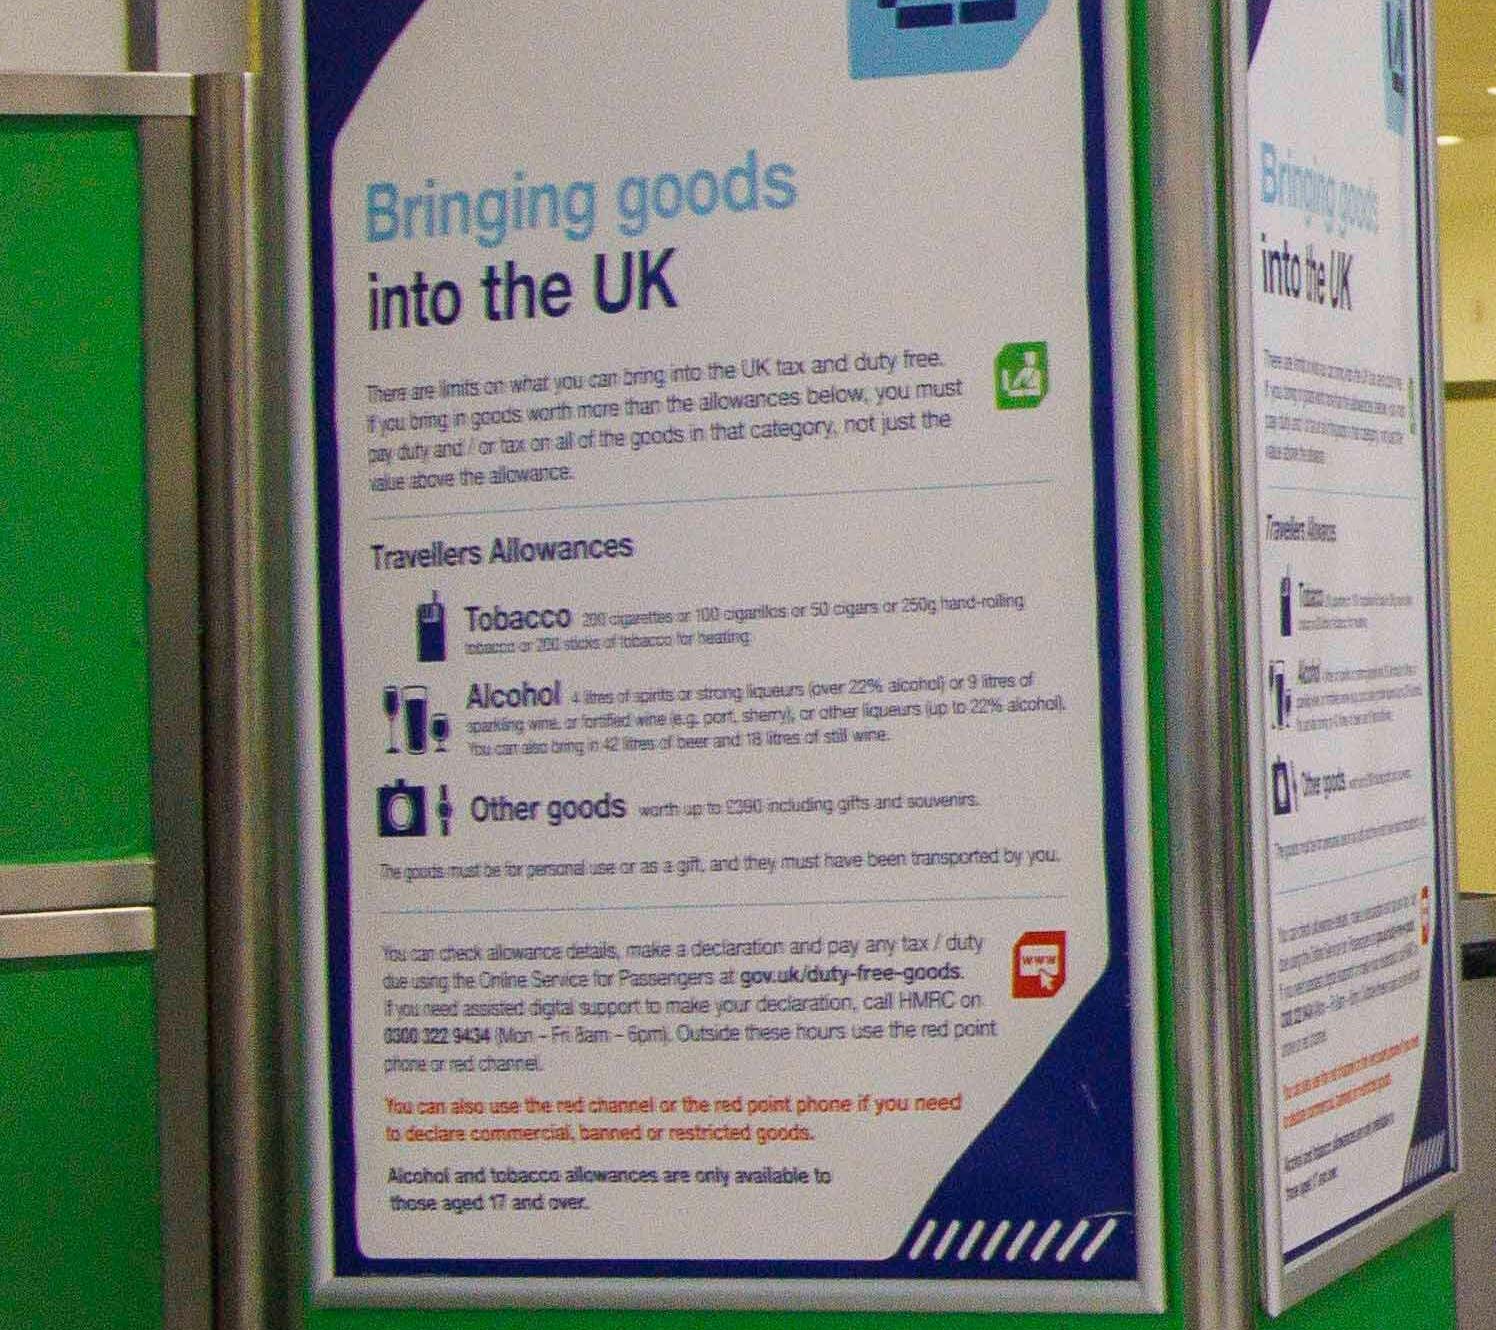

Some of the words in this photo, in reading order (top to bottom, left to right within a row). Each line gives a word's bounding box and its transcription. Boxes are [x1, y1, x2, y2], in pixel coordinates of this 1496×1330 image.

[366, 169, 596, 249] Bringing
[616, 148, 798, 237] goods
[1261, 232, 1301, 298] into
[1305, 243, 1326, 305] the
[1329, 249, 1354, 311] UK
[367, 271, 461, 331] into
[480, 260, 573, 322] the
[593, 247, 678, 314] UK
[366, 384, 408, 402] There
[410, 385, 436, 400] are
[438, 379, 480, 398] limits
[482, 380, 507, 395] on
[509, 374, 550, 394] what
[553, 376, 585, 396] you
[587, 374, 620, 389] can
[622, 368, 667, 389] bring
[669, 365, 704, 384] into
[707, 363, 738, 382] the
[740, 361, 772, 380] UK
[774, 360, 807, 378] tax
[809, 356, 850, 376] and
[853, 354, 900, 376] duty
[366, 414, 377, 433] If
[379, 416, 406, 436] you
[408, 411, 449, 432] bring
[452, 409, 468, 427] in
[470, 406, 523, 430] goods
[525, 402, 574, 422] worth
[576, 403, 621, 419] more
[623, 398, 663, 417] than
[665, 396, 695, 414] the
[698, 392, 803, 412] allowances
[873, 385, 911, 406] you
[913, 378, 964, 398] must
[371, 541, 482, 569] Travellers
[488, 536, 636, 564] Allowances
[464, 604, 572, 631] Tobacco
[465, 680, 561, 708] Alcohol
[471, 794, 540, 822] Other
[547, 792, 627, 826] goods
[386, 1096, 414, 1114] You
[416, 1100, 447, 1114] can
[449, 1096, 486, 1114] also
[488, 1100, 521, 1114] use
[523, 1096, 553, 1114] the
[555, 1095, 585, 1114] red
[587, 1095, 656, 1113] channel
[658, 1099, 678, 1113] or
[680, 1095, 711, 1113] the
[713, 1095, 744, 1113] red
[746, 1094, 793, 1117] point
[795, 1094, 854, 1117] phone
[856, 1094, 870, 1112] if
[872, 1098, 911, 1116] you
[913, 1094, 962, 1112] need
[385, 1125, 402, 1142] to
[404, 1125, 467, 1142] declare
[578, 1124, 643, 1141] banned
[646, 1128, 665, 1141] or
[668, 1124, 752, 1141] restricted
[386, 1167, 451, 1184] Alcohol
[453, 1167, 487, 1184] and
[489, 1167, 562, 1184] tobacco
[564, 1167, 660, 1184] allowances
[662, 1170, 691, 1184] are
[693, 1167, 731, 1188] only
[733, 1167, 810, 1184] available
[812, 1167, 833, 1184] to
[389, 1194, 438, 1211] those
[440, 1194, 485, 1215] aged
[487, 1193, 508, 1210] 17
[510, 1193, 545, 1210] and
